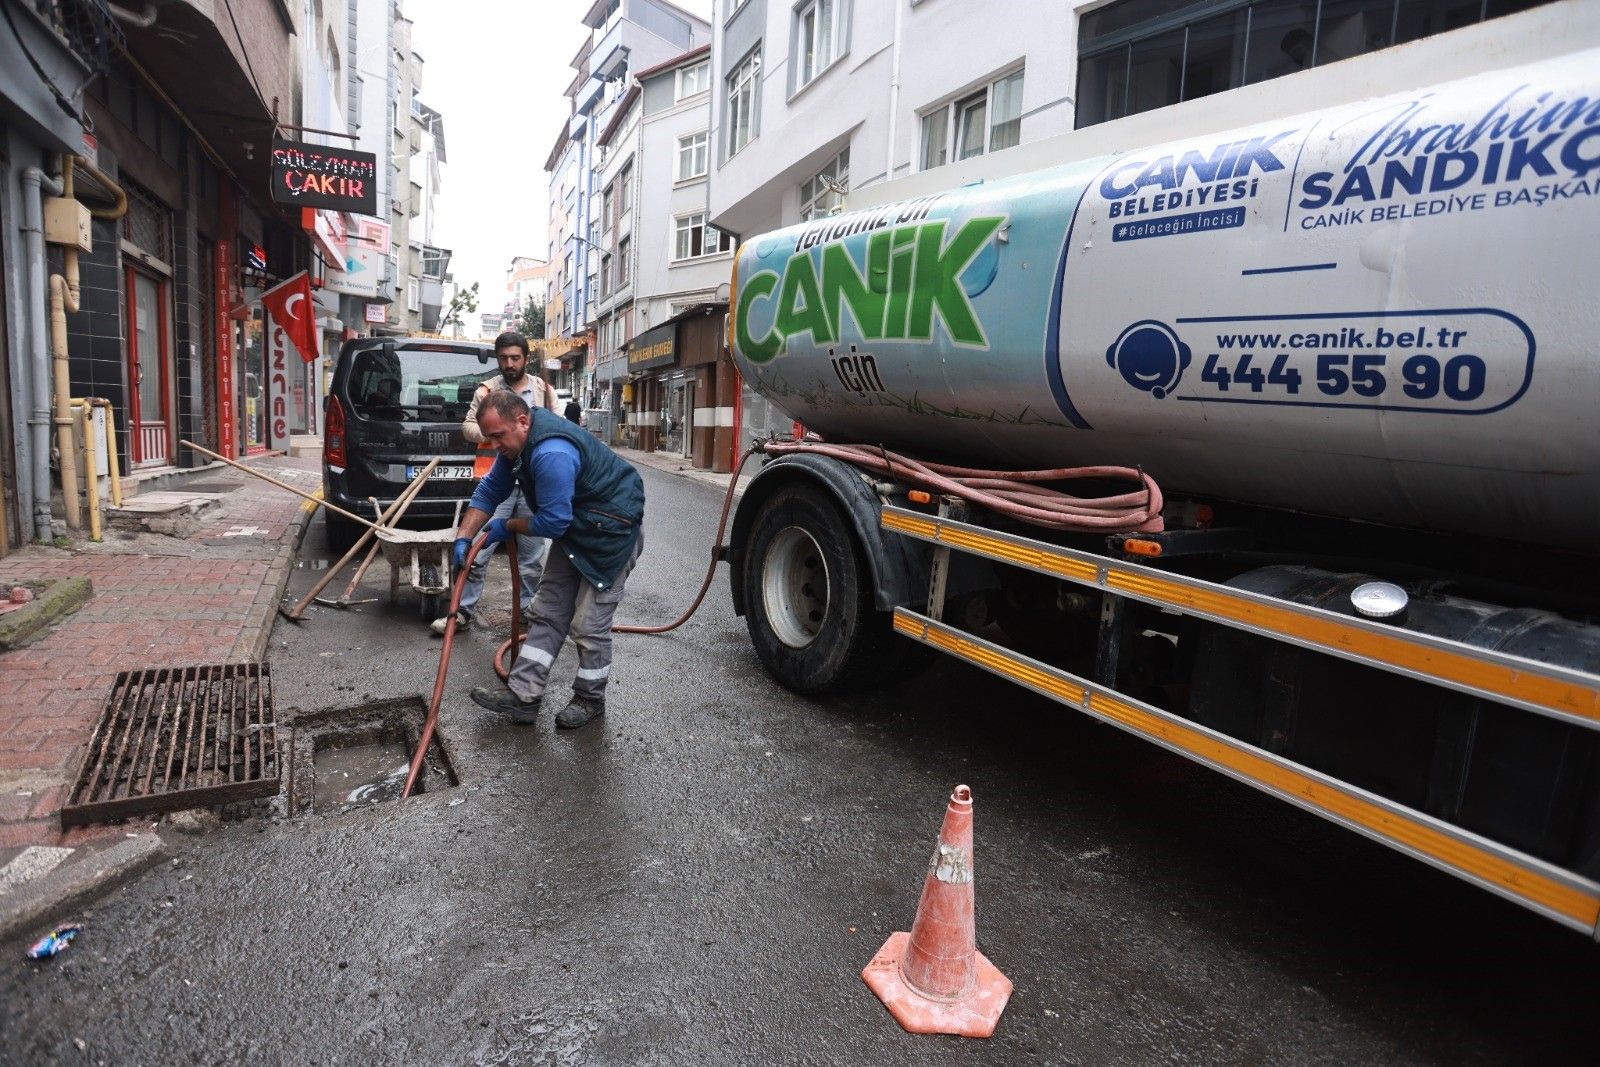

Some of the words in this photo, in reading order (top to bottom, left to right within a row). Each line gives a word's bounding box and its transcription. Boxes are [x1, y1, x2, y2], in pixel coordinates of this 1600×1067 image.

[273, 148, 374, 178] SÜLEYMAN
[285, 170, 364, 198] ÇAKIR
[1118, 217, 1194, 238] #Geleceğin
[1197, 211, 1240, 229] İncisi
[1301, 208, 1364, 230] CANİK
[1370, 193, 1487, 222] BELEDİYE
[1216, 327, 1468, 349] www.canik.bel.tr
[272, 316, 286, 439] czane
[829, 346, 887, 398] için
[1201, 354, 1302, 394] 444
[1316, 354, 1387, 397] 55
[1402, 354, 1487, 402] 90
[428, 432, 450, 448] FIAT
[432, 465, 449, 478] APP
[454, 466, 472, 478] 723
